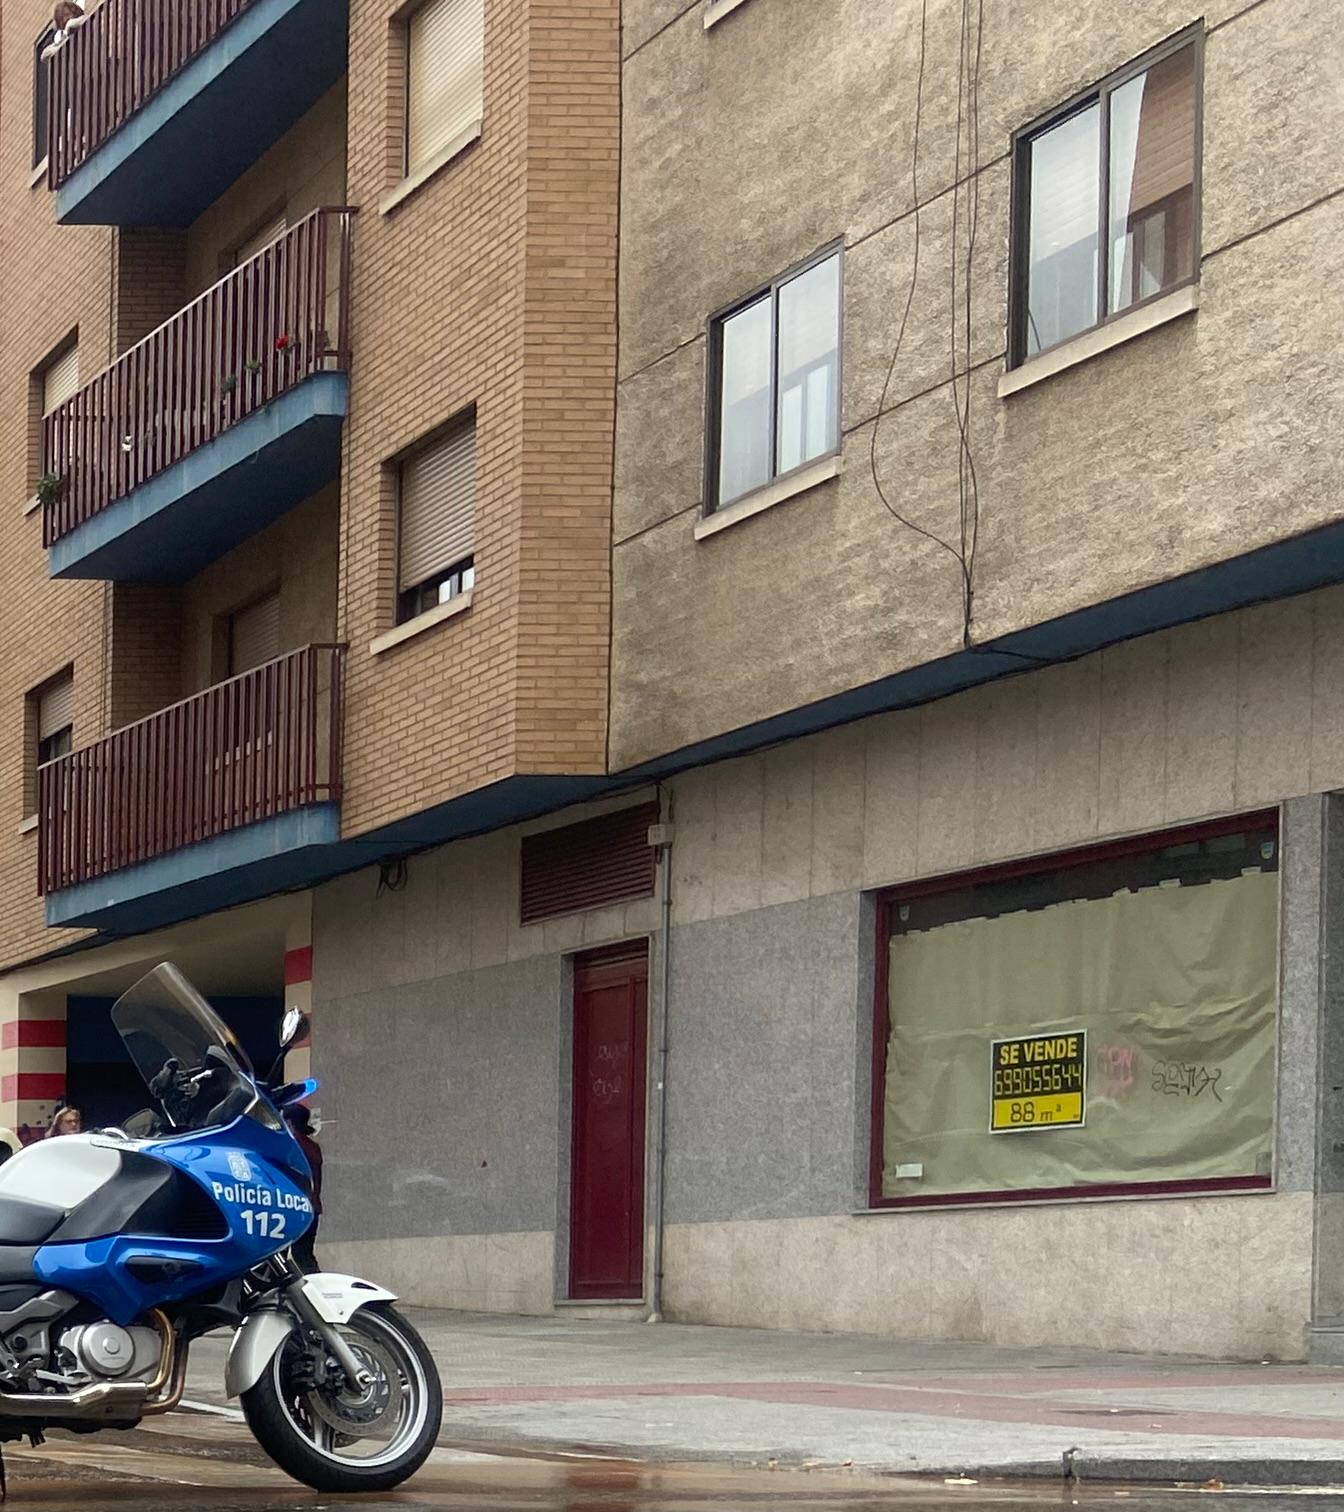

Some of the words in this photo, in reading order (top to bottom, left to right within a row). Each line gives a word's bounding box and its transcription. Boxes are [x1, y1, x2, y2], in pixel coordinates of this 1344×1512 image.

[1000, 1044, 1019, 1065] SE
[1023, 1037, 1077, 1062] VENDE
[994, 1064, 1081, 1095] 699055644
[1010, 1102, 1035, 1122] 88
[212, 1181, 271, 1206] Policía
[240, 1209, 286, 1239] 112
